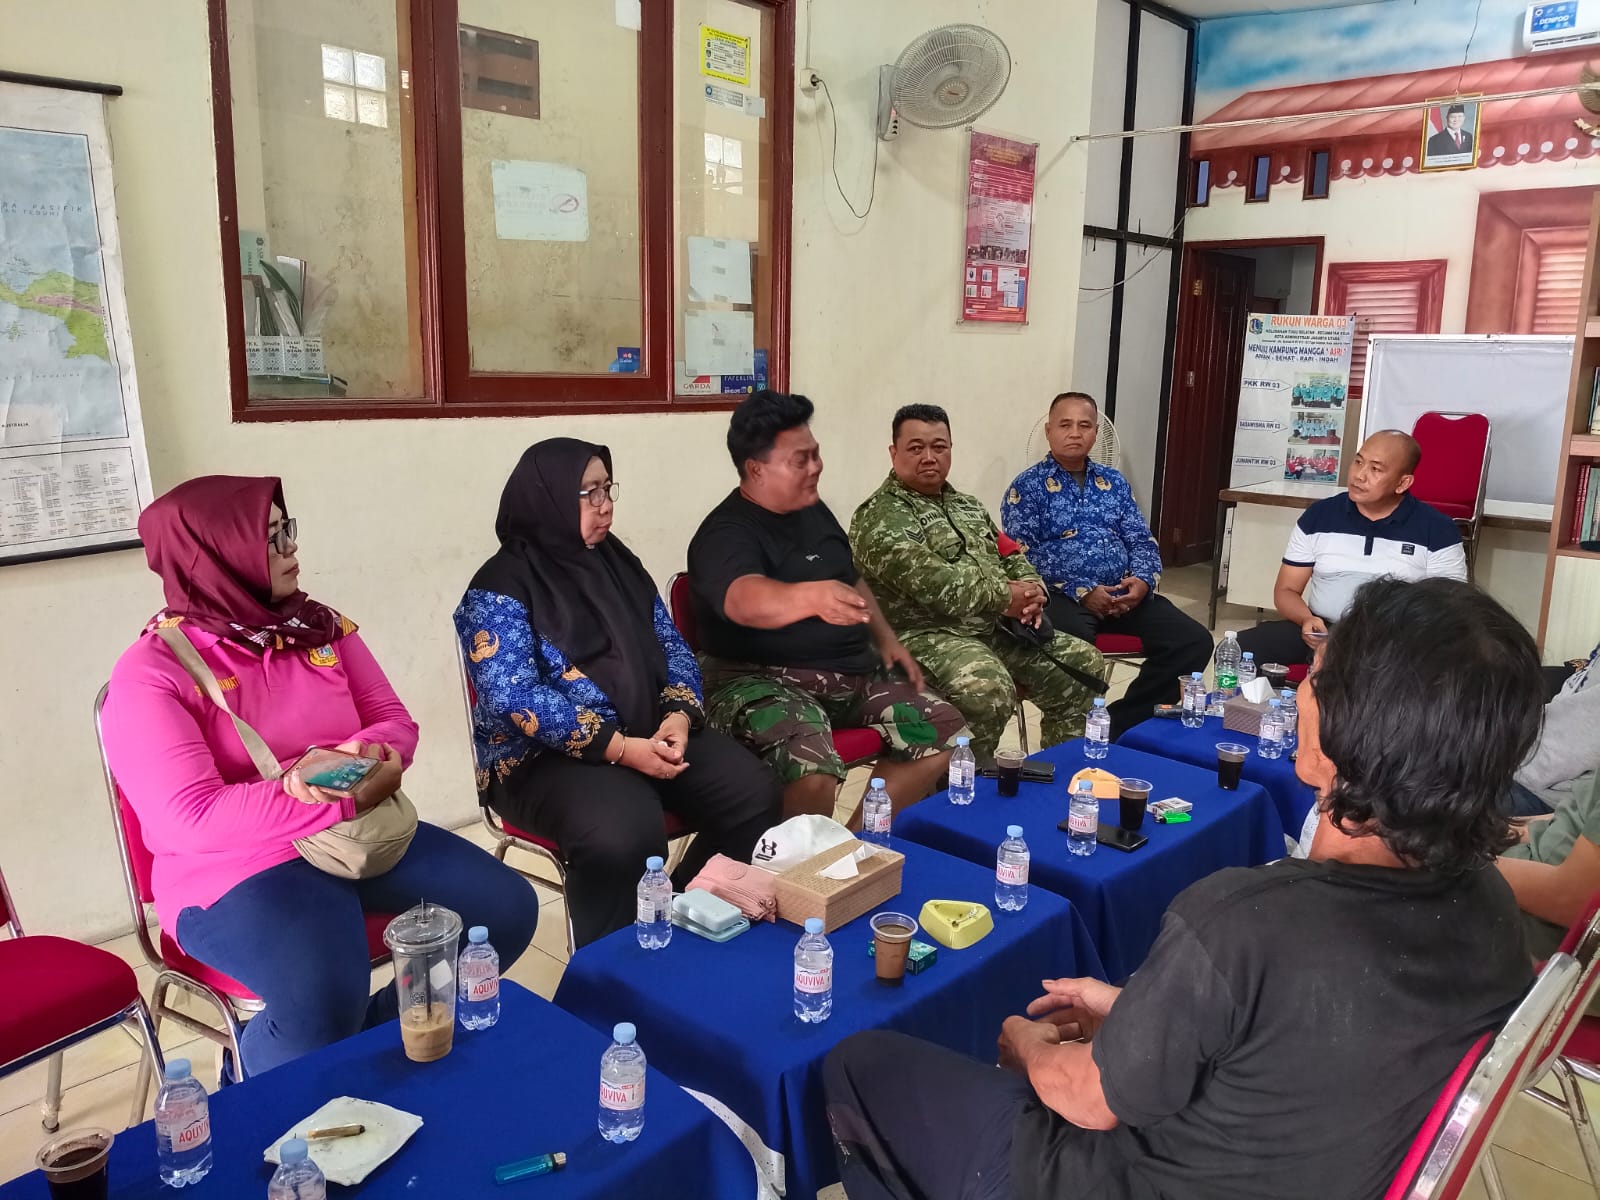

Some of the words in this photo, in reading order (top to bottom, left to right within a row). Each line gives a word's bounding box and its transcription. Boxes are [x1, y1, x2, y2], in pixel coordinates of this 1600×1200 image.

[1270, 316, 1301, 327] RUKUN
[1303, 317, 1335, 328] WARGA
[1336, 319, 1347, 329] 03
[1247, 343, 1268, 353] MENUJU
[1268, 344, 1298, 354] KAMPUNG
[1299, 346, 1325, 355] MANGGA
